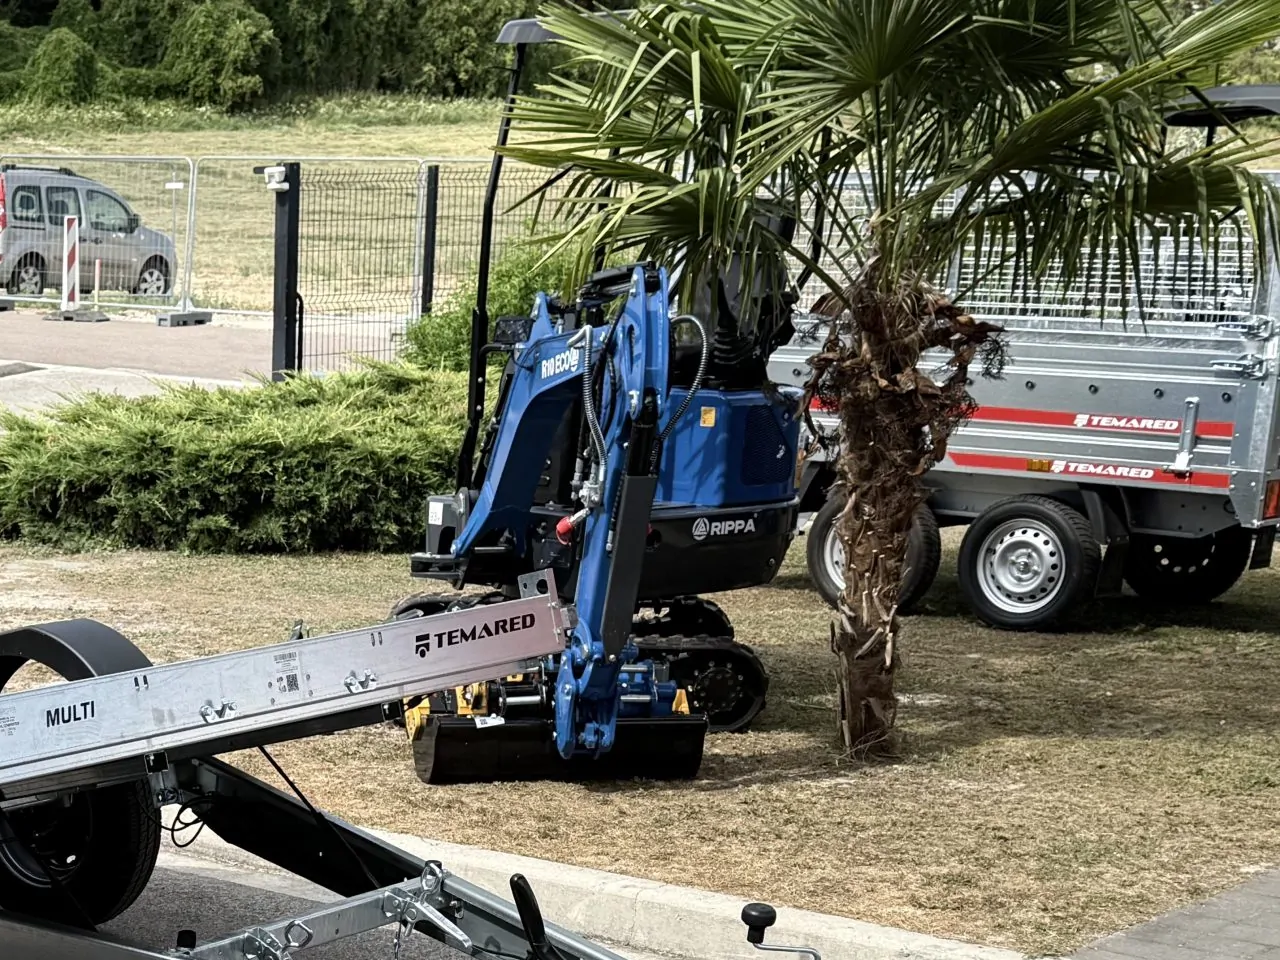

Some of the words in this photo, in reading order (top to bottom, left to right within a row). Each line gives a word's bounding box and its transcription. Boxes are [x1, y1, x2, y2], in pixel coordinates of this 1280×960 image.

[541, 357, 555, 380] R10
[555, 350, 570, 374] ECO
[1090, 415, 1179, 430] TEMARED
[1067, 462, 1154, 479] TEMARED
[710, 518, 756, 536] RIPPA
[433, 613, 536, 649] TEMARED
[46, 700, 95, 728] MULTI
